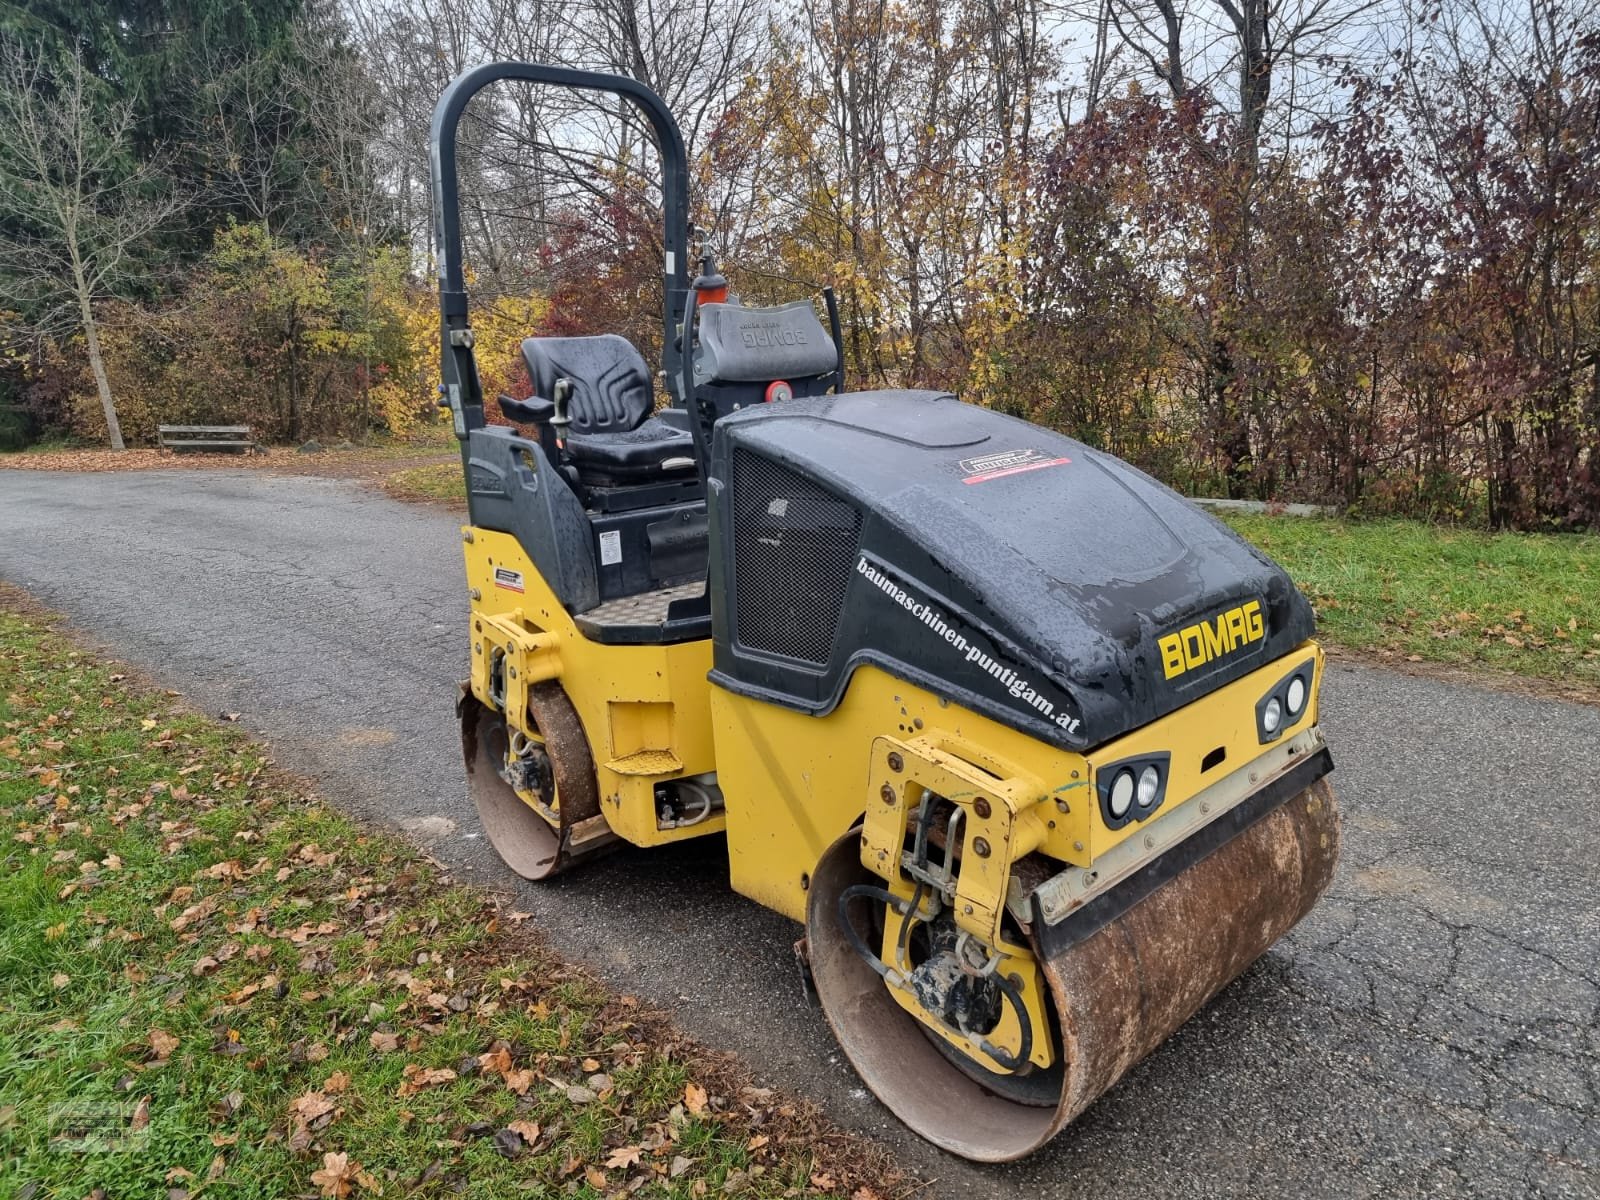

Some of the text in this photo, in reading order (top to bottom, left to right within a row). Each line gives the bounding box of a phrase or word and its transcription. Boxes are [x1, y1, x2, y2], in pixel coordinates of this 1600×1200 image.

[741, 328, 809, 349] BOMAG
[856, 557, 1081, 734] baumaschinen-puntigam.at
[1158, 600, 1264, 680] BOMAG
